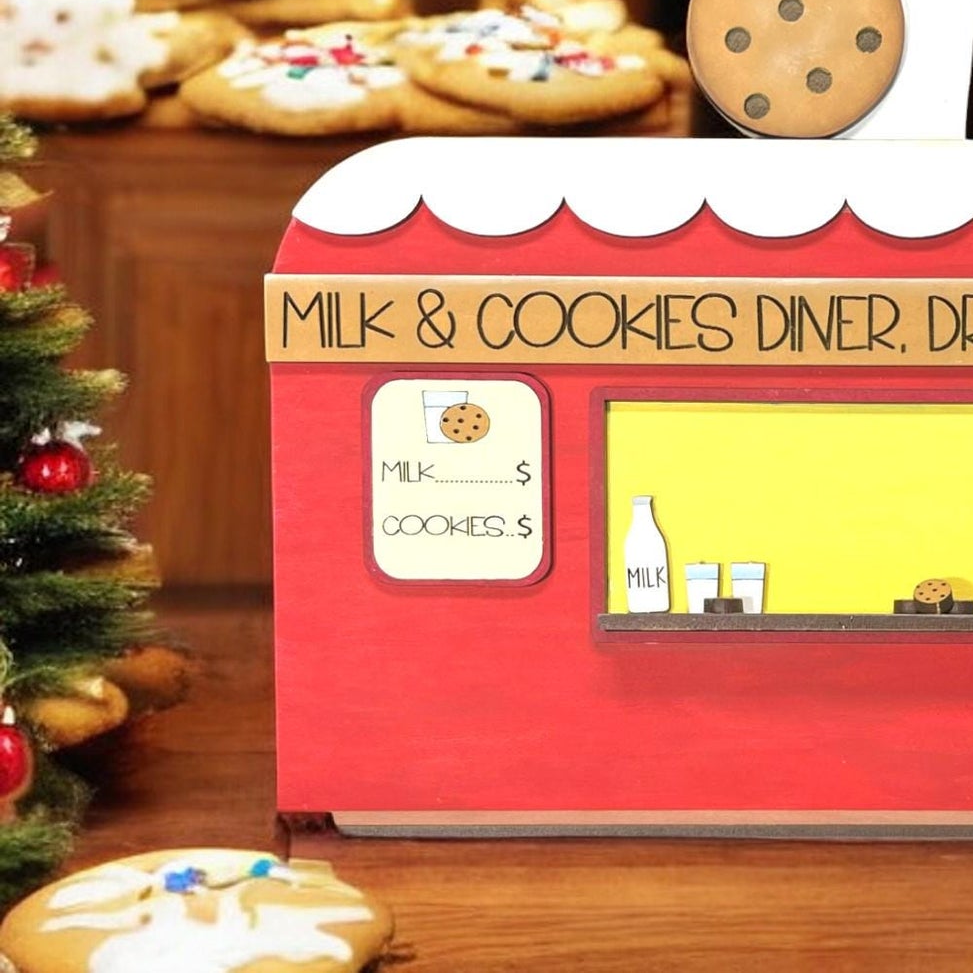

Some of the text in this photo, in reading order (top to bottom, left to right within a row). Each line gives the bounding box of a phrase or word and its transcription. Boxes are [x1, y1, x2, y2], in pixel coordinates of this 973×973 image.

[282, 291, 395, 349] MILK
[416, 288, 456, 349] &
[476, 290, 738, 353] COOKIES
[627, 566, 667, 589] MILK
